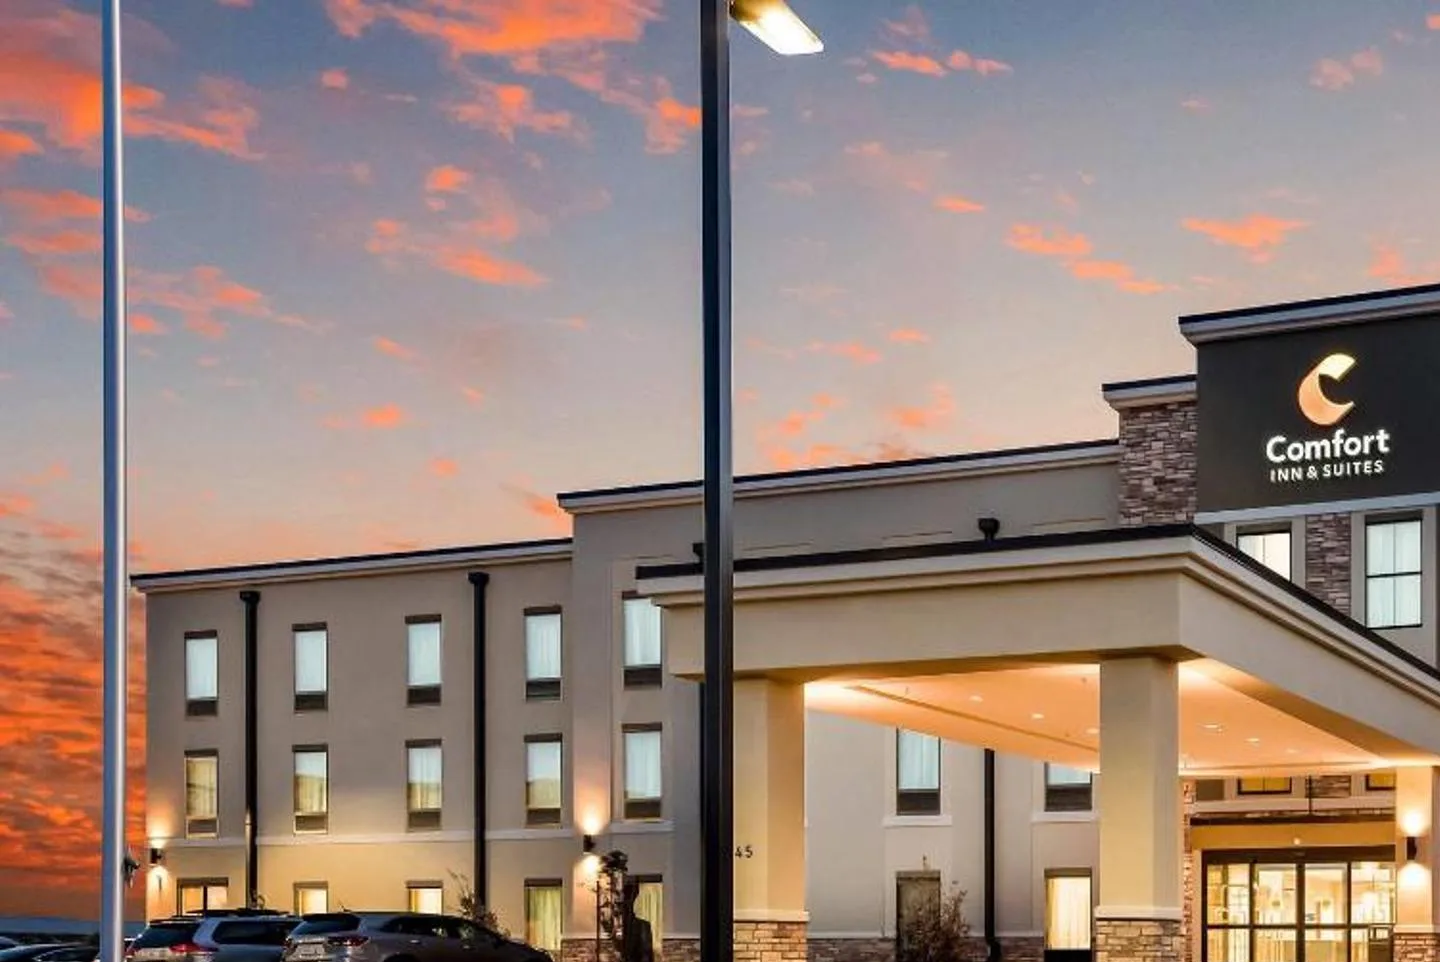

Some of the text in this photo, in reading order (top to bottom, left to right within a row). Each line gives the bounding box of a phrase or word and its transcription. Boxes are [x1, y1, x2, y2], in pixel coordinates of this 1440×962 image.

[1266, 428, 1390, 463] Comfort
[1270, 460, 1384, 482] INN & SUITES
